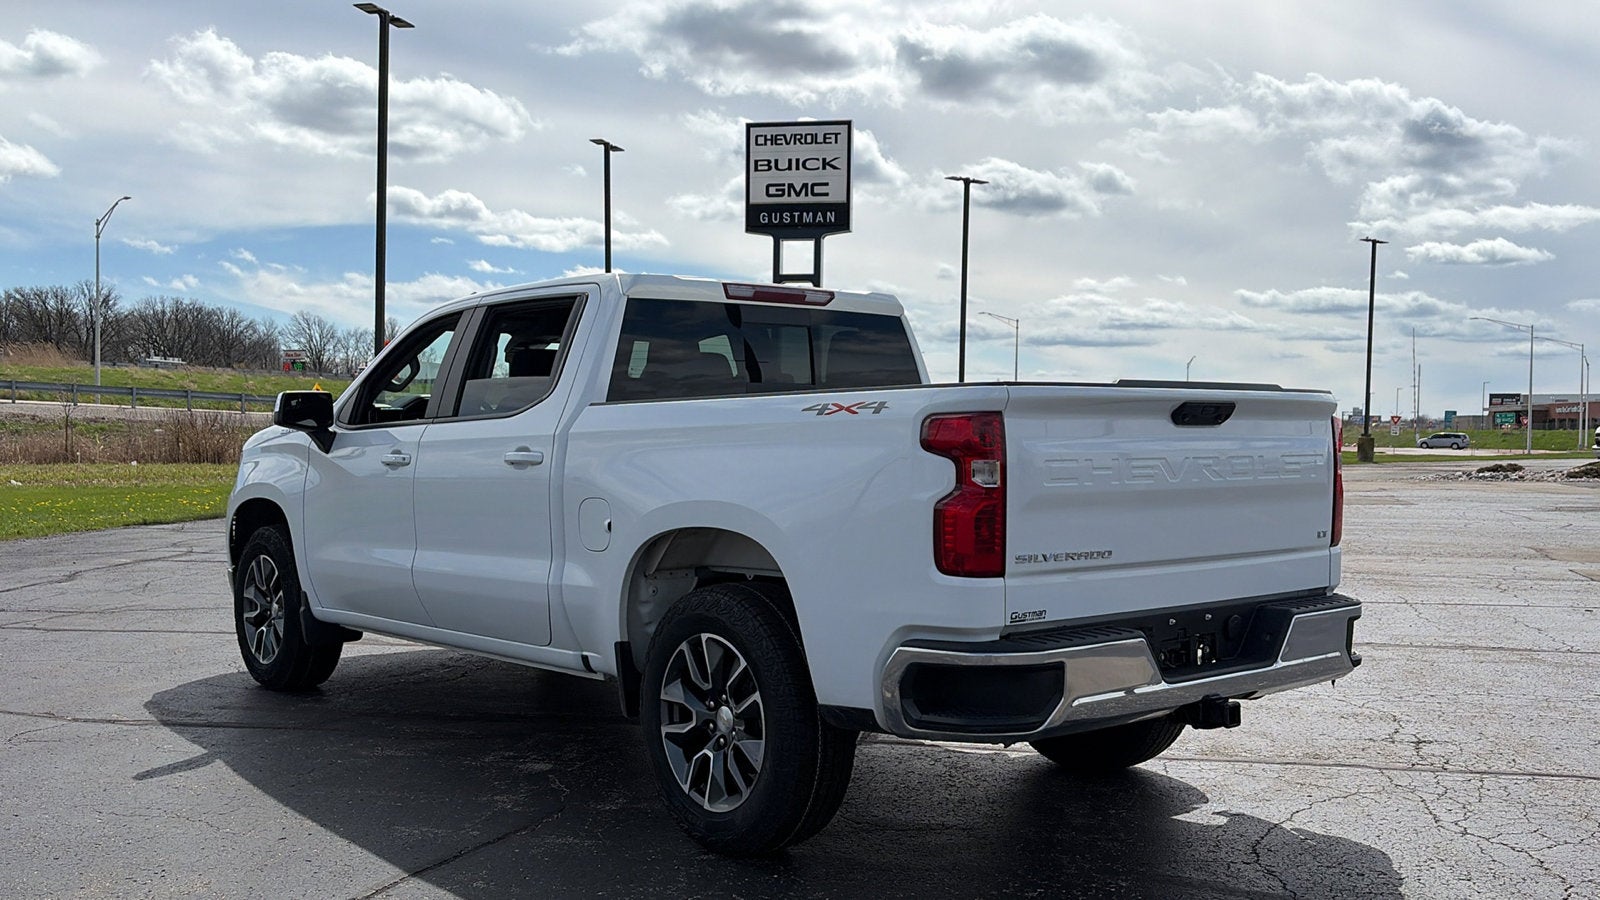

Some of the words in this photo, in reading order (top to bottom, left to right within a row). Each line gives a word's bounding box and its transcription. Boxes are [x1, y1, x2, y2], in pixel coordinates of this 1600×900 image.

[754, 132, 842, 146] CHEVROLET
[753, 156, 842, 172] BUICK
[765, 182, 830, 198] GMC
[759, 211, 836, 224] GUSTMAN
[1042, 453, 1325, 487] CHEVROLET
[1014, 550, 1113, 564] SILVERADO
